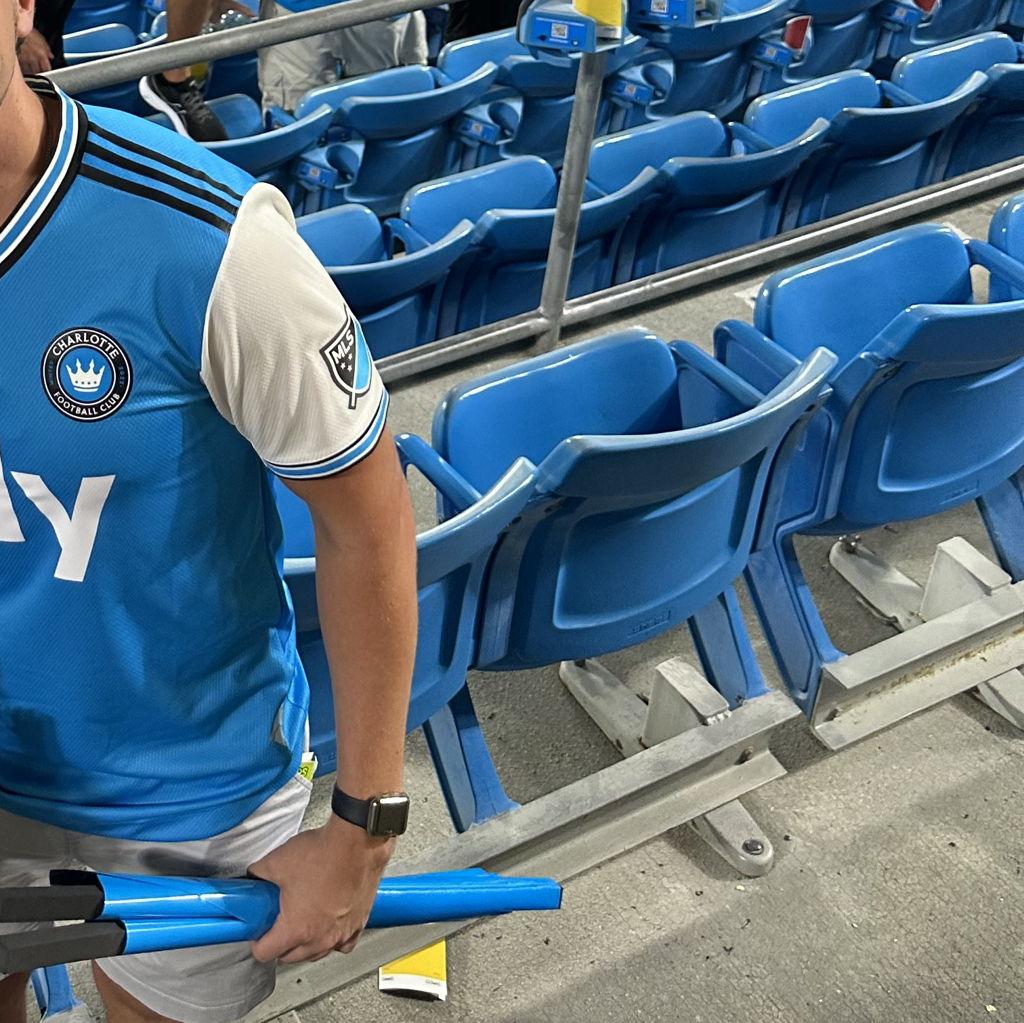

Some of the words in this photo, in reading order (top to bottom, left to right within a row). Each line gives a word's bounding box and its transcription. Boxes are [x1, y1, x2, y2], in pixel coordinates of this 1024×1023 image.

[52, 332, 120, 360] CHARLOTTE
[331, 329, 355, 365] MLS
[53, 391, 97, 416] FOOTBALL
[99, 393, 120, 412] CLUB
